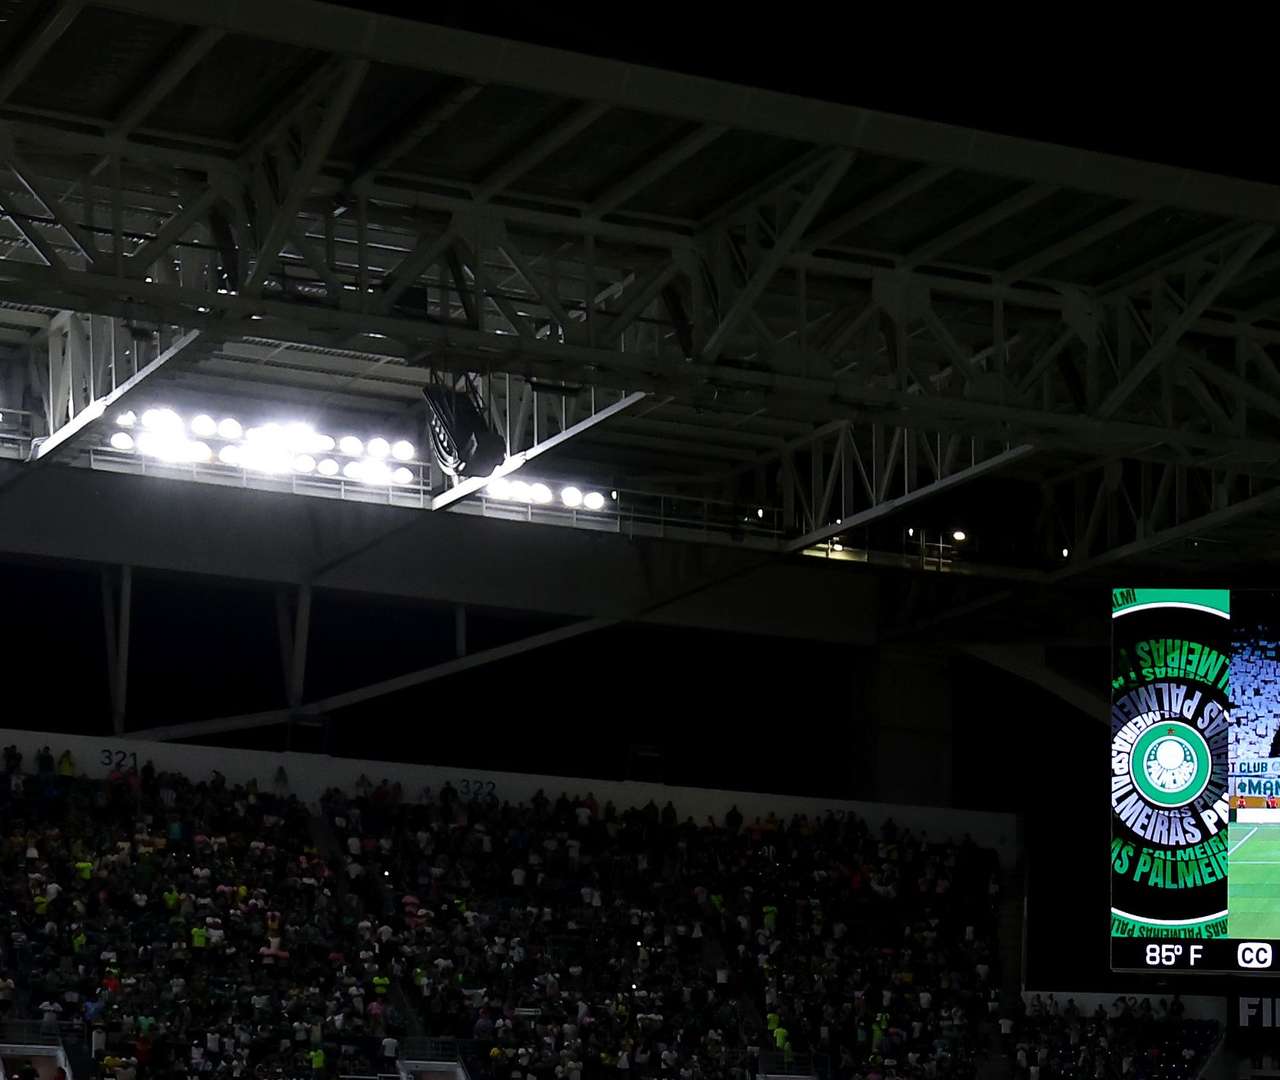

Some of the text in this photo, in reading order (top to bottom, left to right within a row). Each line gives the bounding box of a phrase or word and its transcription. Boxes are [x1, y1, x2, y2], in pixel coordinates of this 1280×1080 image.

[101, 749, 137, 768] 321
[1239, 760, 1268, 773] CLUB
[1190, 945, 1204, 966] F
[1240, 946, 1269, 965] CC
